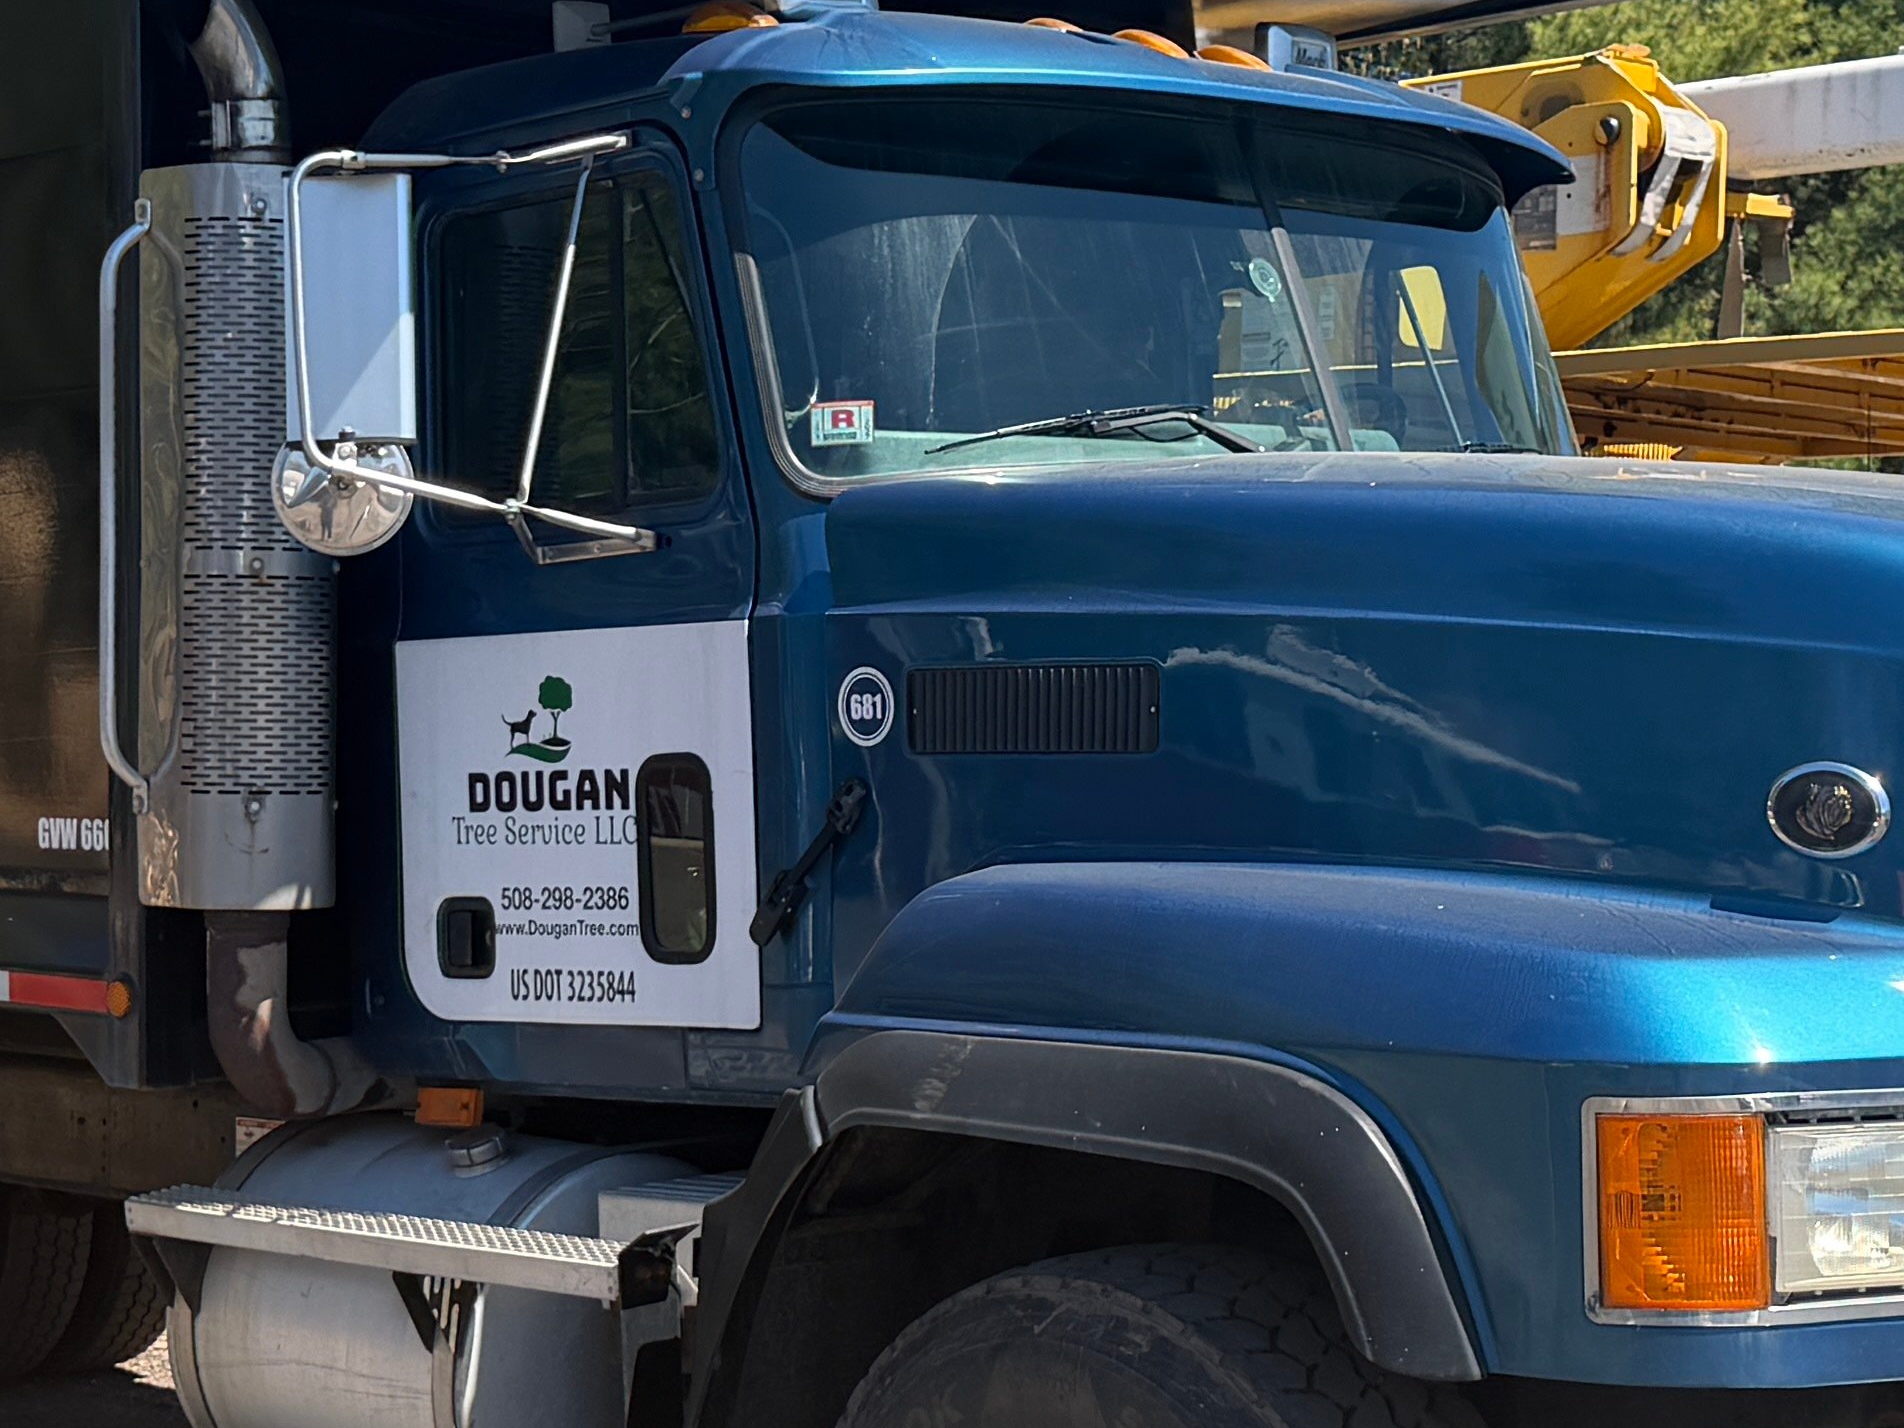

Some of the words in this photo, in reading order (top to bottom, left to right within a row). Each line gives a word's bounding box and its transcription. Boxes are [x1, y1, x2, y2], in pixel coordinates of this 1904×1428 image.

[831, 409, 855, 429] R
[850, 693, 882, 720] 681
[468, 768, 631, 813] DOUGAN
[38, 817, 77, 850] GVW
[452, 815, 497, 845] Tree
[505, 815, 586, 846] Service
[595, 815, 637, 845] LLC
[500, 886, 631, 911] 508-298-2386
[510, 968, 531, 1002] US
[534, 968, 563, 1002] DOT
[567, 969, 637, 1003] 3235844
